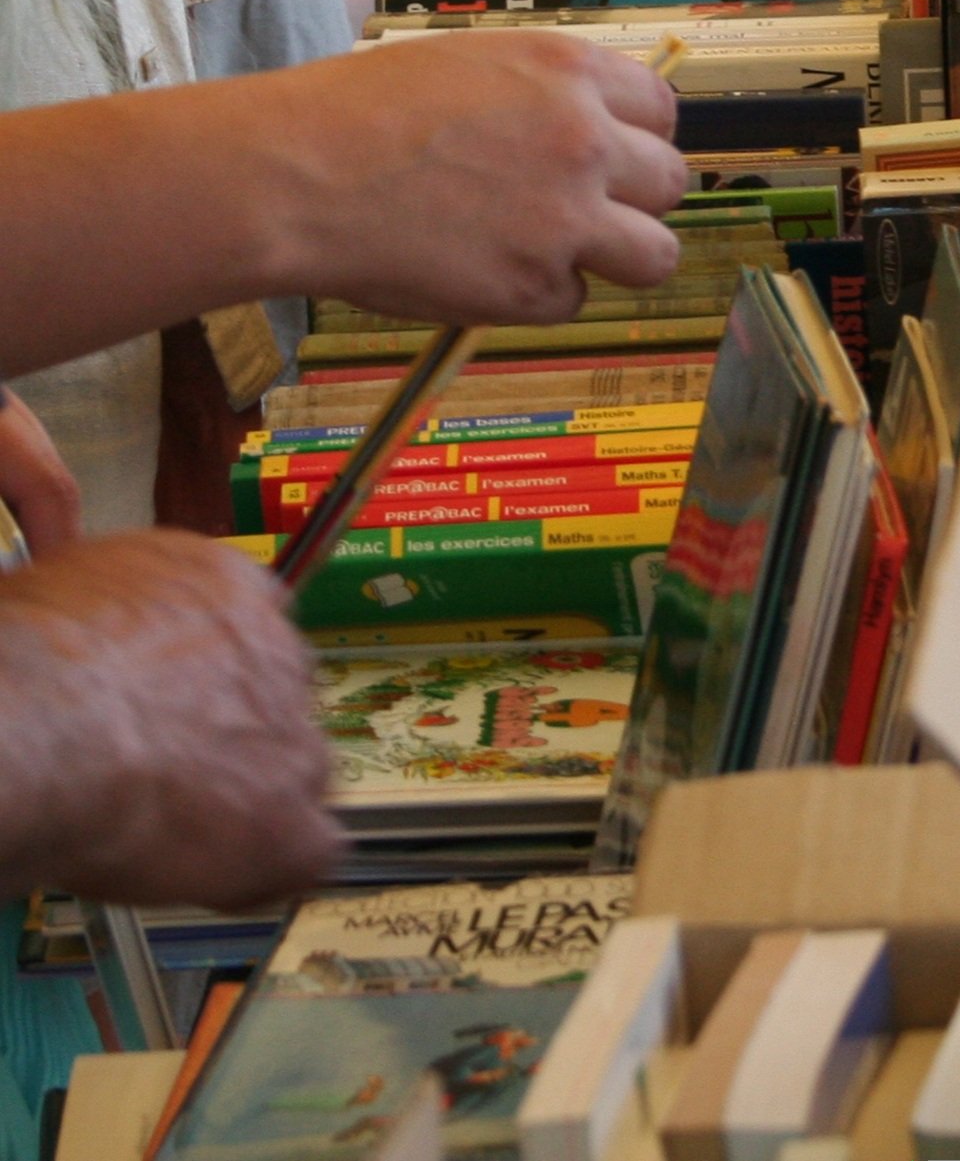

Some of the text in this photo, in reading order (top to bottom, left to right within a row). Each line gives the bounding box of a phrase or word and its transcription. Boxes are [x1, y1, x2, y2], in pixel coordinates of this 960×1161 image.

[443, 418, 471, 428] les
[475, 415, 532, 427] bases
[579, 409, 636, 420] Histoire
[467, 424, 558, 438] exercices
[463, 450, 547, 463] l'examen
[481, 474, 568, 490] l'examen
[620, 470, 667, 482] Maths
[384, 504, 482, 522] PREP@BAC
[503, 502, 591, 517] l'examen
[407, 539, 436, 553] les
[441, 532, 535, 552] exercices
[547, 531, 595, 545] Maths
[466, 900, 529, 932] LE
